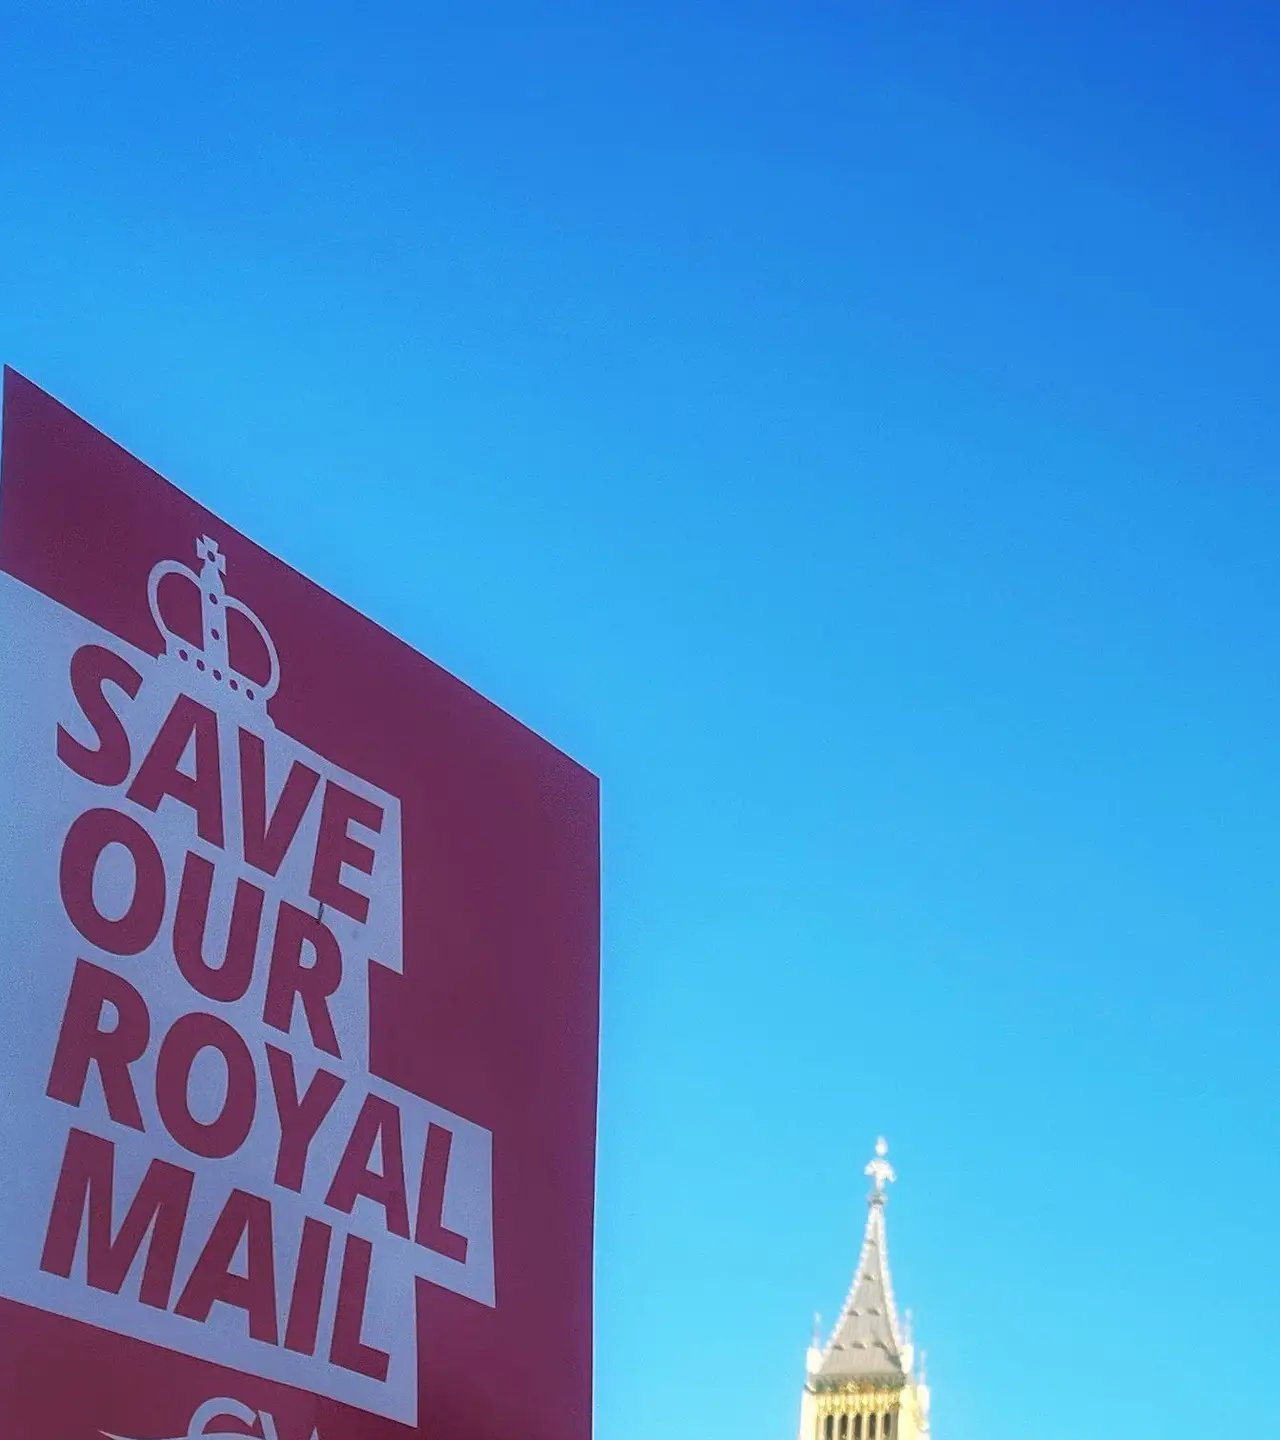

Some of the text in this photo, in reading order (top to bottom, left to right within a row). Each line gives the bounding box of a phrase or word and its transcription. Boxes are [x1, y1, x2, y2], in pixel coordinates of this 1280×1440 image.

[56, 644, 384, 925] SAVE
[59, 806, 343, 1061] OUR
[45, 956, 469, 1265] ROYAL
[39, 1126, 390, 1383] MAIL
